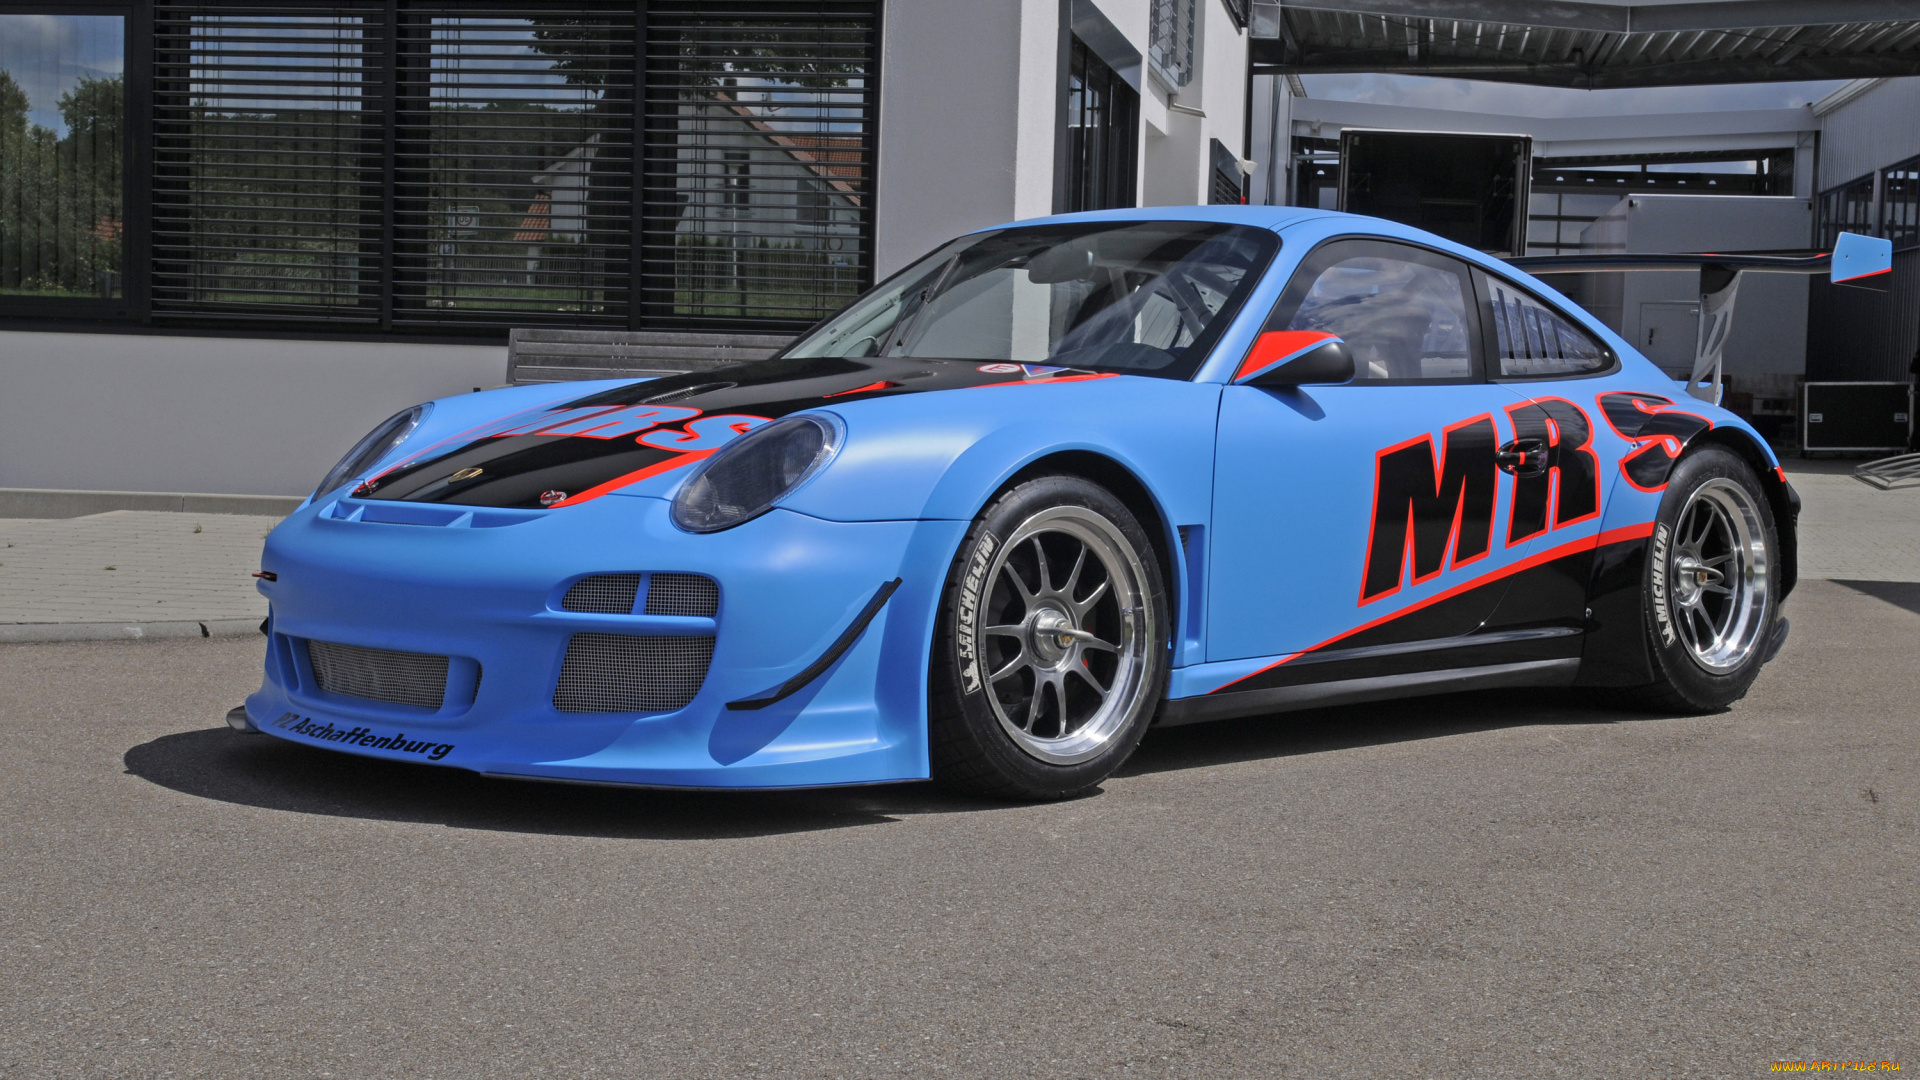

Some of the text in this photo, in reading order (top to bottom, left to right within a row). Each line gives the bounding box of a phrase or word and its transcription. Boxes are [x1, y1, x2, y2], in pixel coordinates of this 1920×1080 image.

[1356, 391, 1714, 608] MRS
[959, 534, 994, 659] MICHELIN
[1653, 525, 1668, 622] MICHELIN
[289, 717, 455, 761] Aschaffenburg
